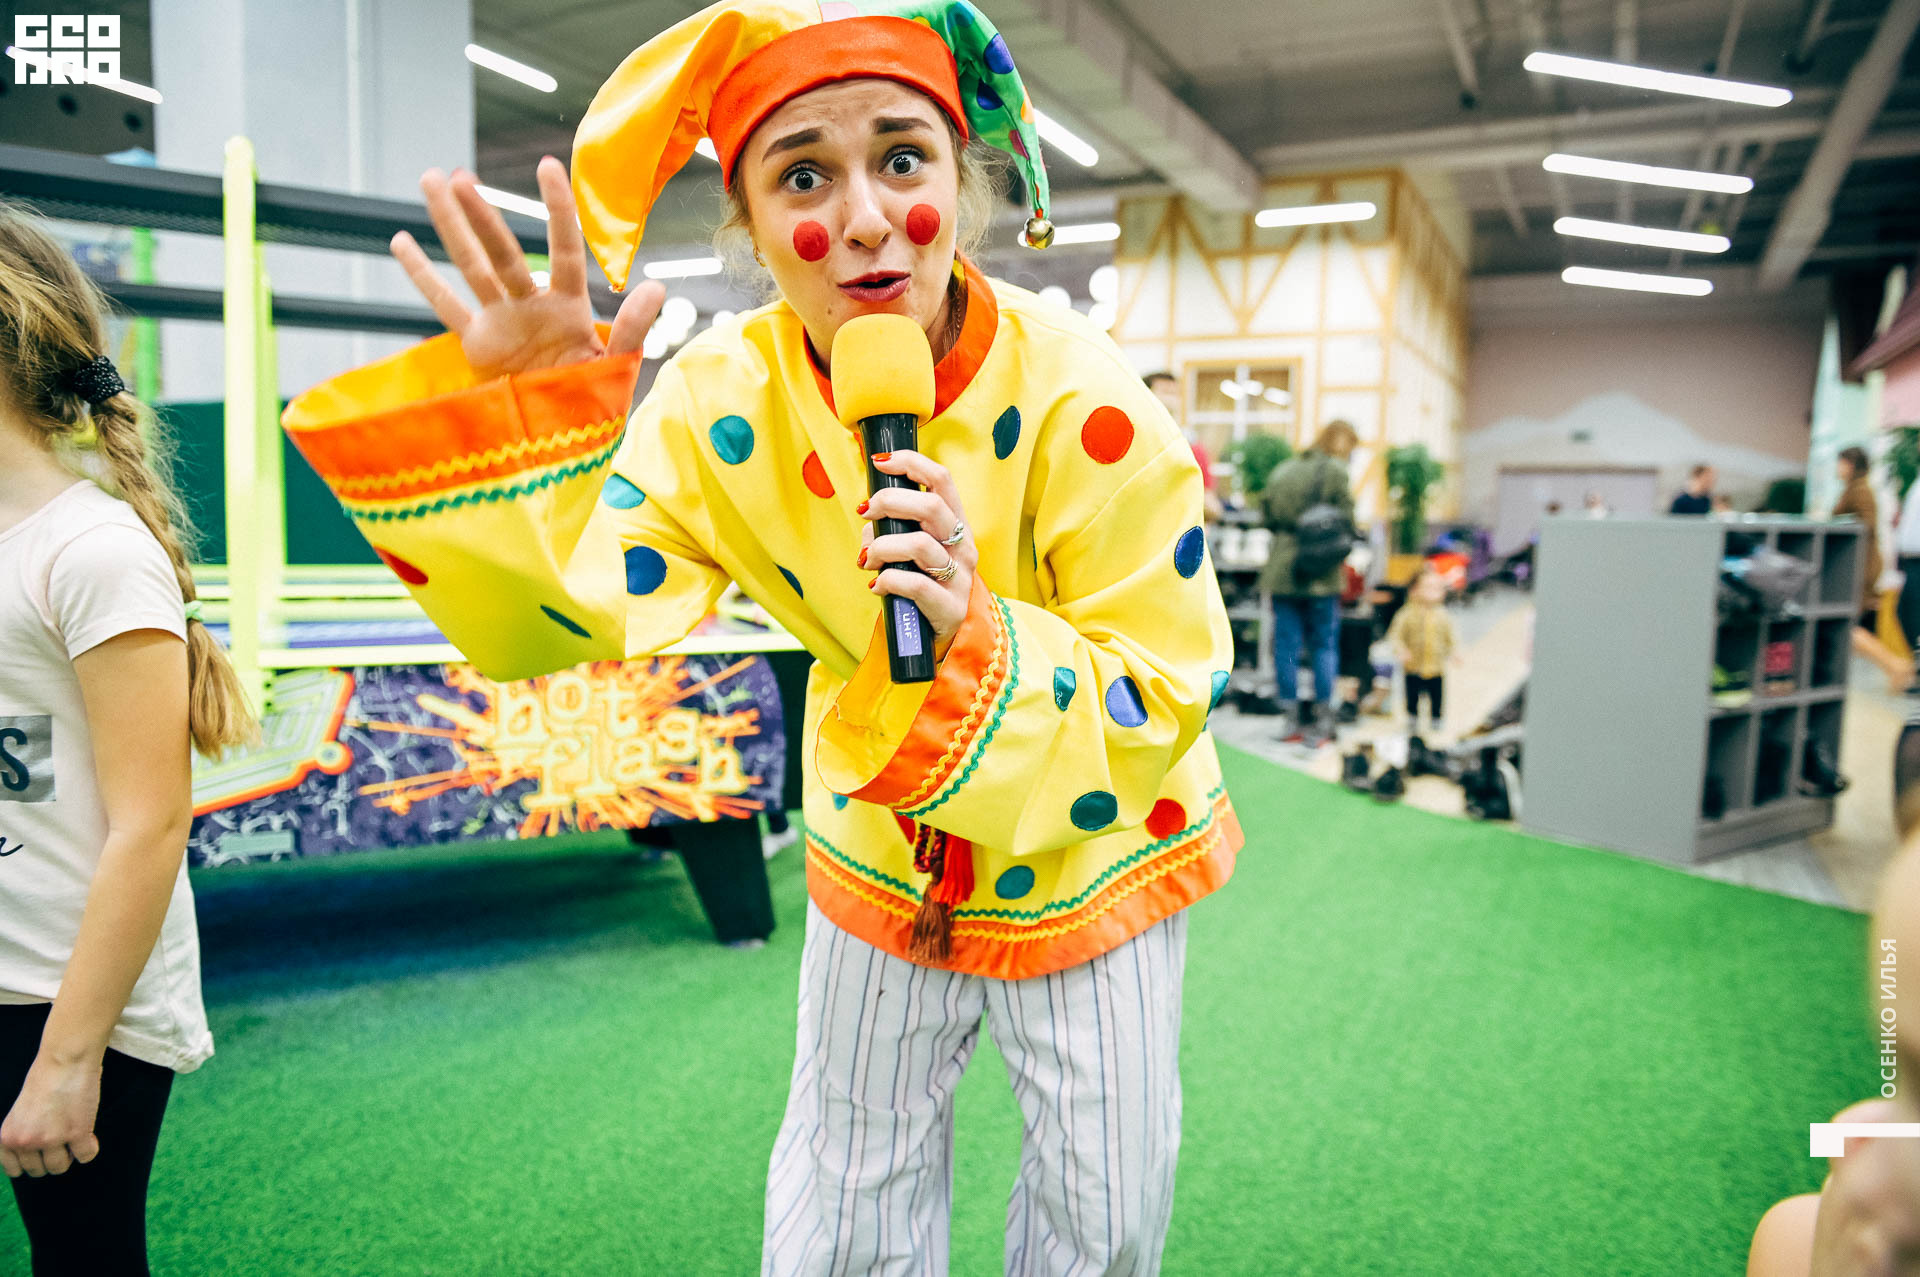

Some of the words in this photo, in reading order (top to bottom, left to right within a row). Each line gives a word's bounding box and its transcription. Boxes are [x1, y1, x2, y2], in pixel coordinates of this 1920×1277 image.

[902, 612, 912, 639] UHF
[495, 673, 638, 748] hot
[522, 708, 750, 811] flash
